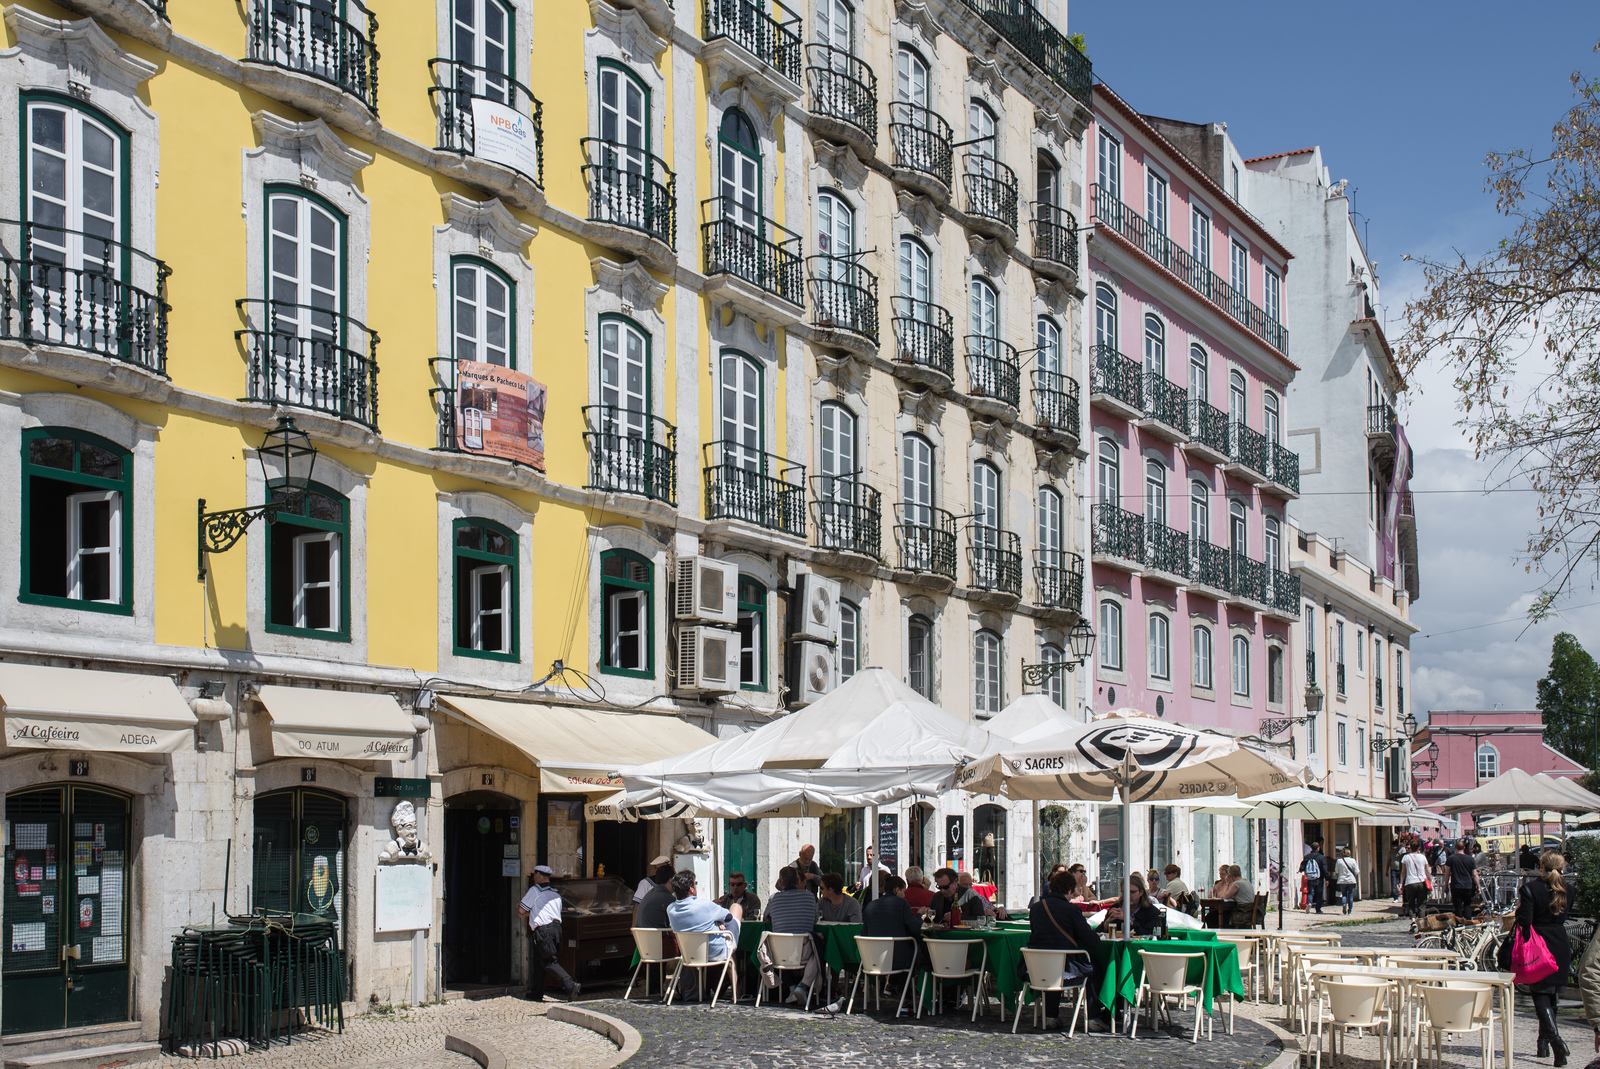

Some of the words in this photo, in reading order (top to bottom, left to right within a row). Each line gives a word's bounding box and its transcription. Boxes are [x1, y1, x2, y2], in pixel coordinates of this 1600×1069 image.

[462, 371, 488, 381] Marques
[497, 377, 517, 388] Pacheco
[120, 734, 157, 745] ADEGA
[316, 741, 340, 751] ATUM
[1024, 756, 1064, 770] SAGRES
[568, 776, 592, 785] SOLAR
[594, 804, 611, 814] SAGRES
